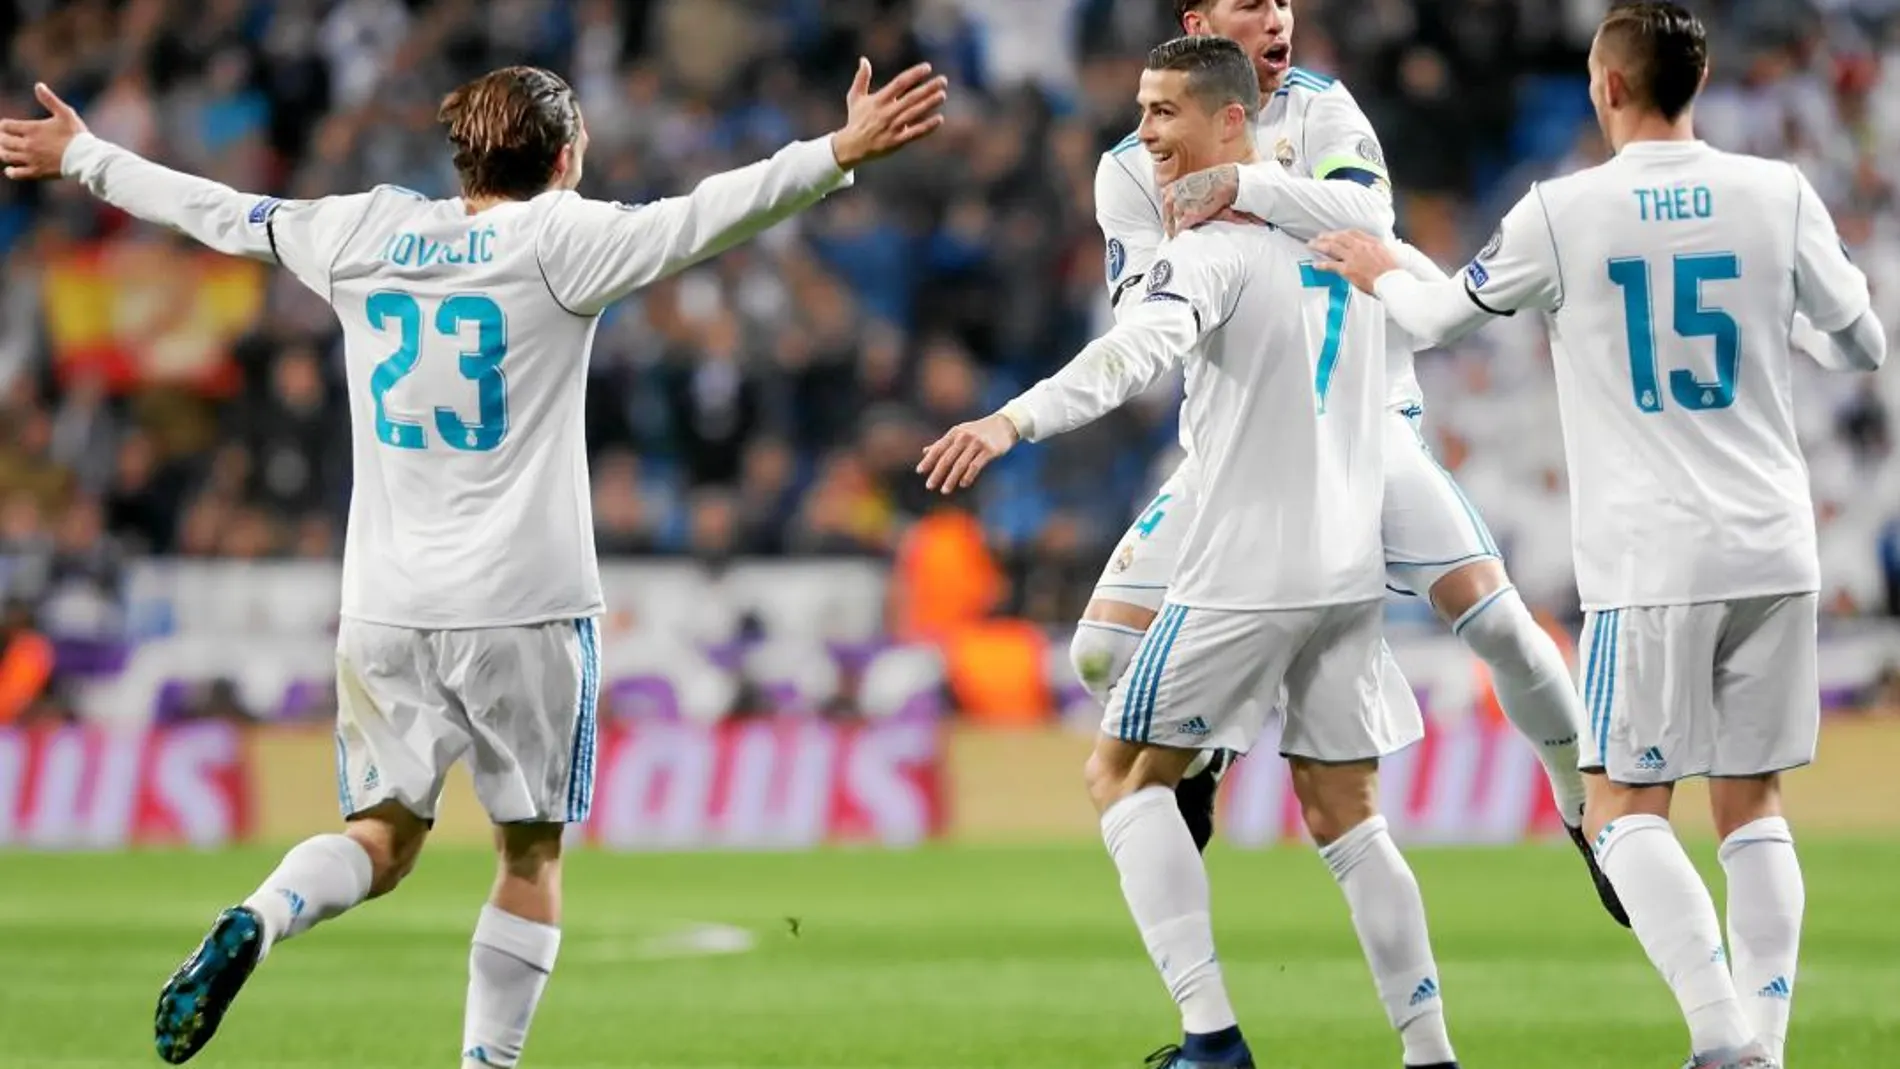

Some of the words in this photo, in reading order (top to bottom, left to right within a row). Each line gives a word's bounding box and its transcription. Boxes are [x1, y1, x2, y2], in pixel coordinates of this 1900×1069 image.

[1633, 187, 1712, 220] THEO
[366, 289, 510, 451] 23
[1298, 259, 1352, 415] 7
[1608, 251, 1741, 412] 15
